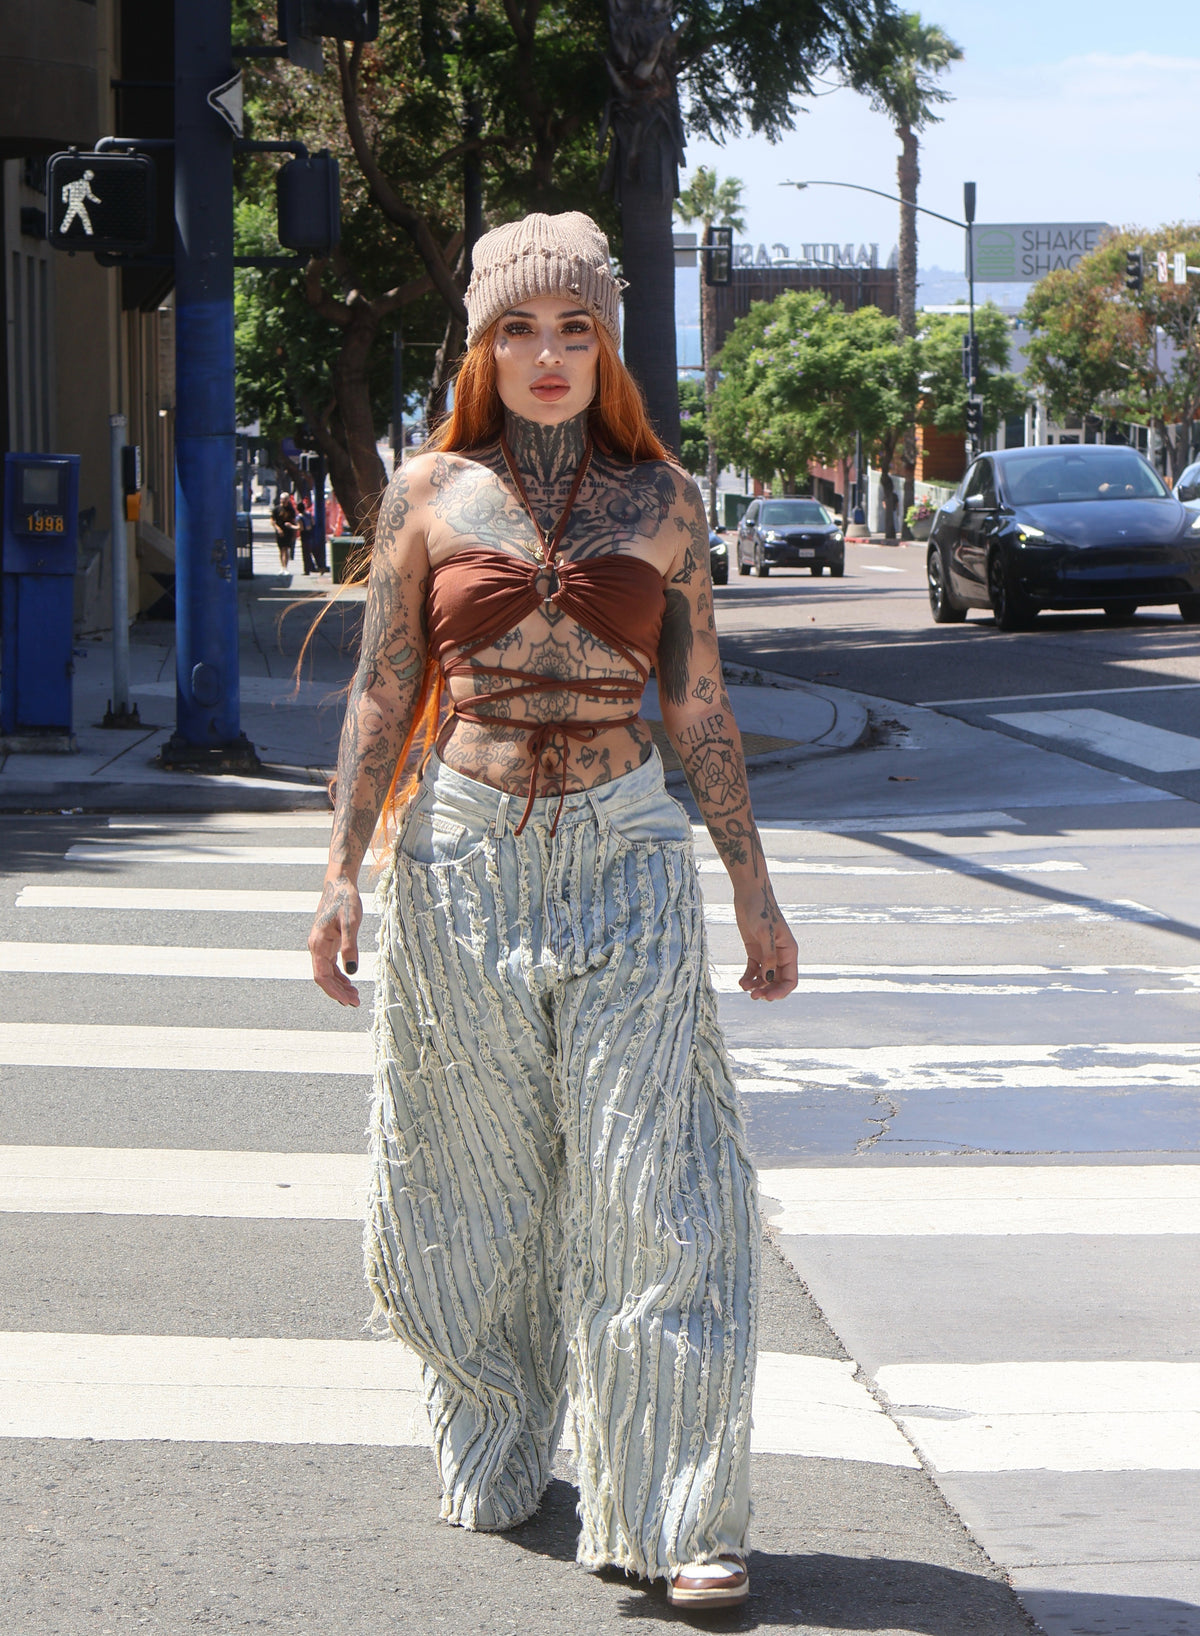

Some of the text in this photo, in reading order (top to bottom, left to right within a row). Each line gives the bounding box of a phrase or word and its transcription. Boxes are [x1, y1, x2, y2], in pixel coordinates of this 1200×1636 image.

[1021, 228, 1097, 251] SHAKE
[26, 514, 64, 533] 1998
[676, 713, 727, 745] KILLER
